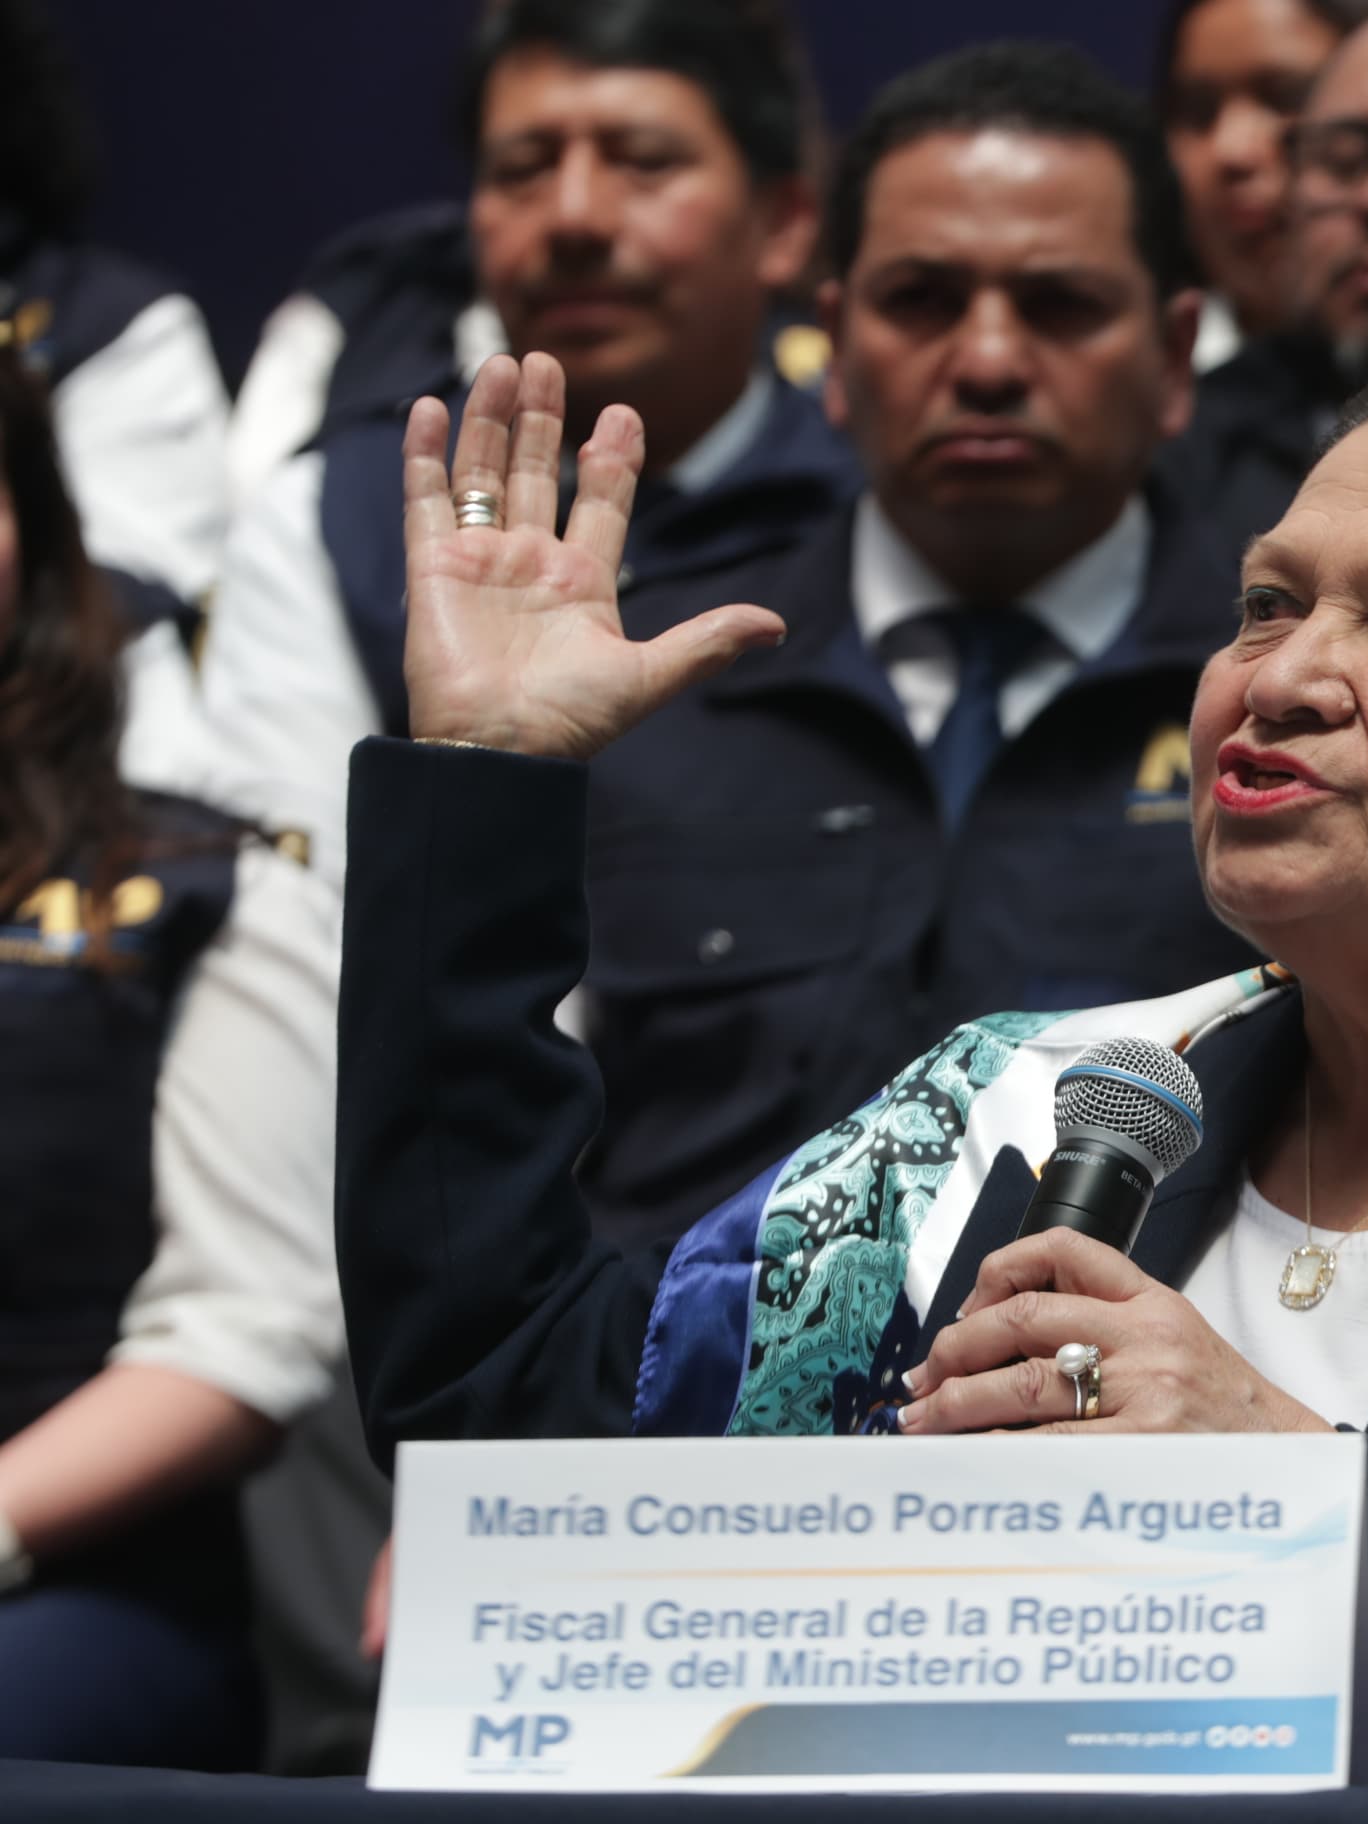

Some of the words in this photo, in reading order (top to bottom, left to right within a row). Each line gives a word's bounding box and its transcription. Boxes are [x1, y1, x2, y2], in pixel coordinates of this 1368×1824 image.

[1054, 1151, 1100, 1168] SHURE
[1120, 1169, 1143, 1192] BETA
[468, 1494, 609, 1538] María
[626, 1494, 875, 1536] Consuelo
[893, 1492, 1062, 1533] Porras
[1078, 1491, 1283, 1542] Argueta
[472, 1601, 626, 1643] Fiscal
[643, 1600, 847, 1640] General
[864, 1599, 929, 1638] de
[946, 1598, 989, 1637] la
[1008, 1594, 1267, 1645] República
[494, 1661, 526, 1702] y
[539, 1652, 651, 1691] Jefe
[668, 1650, 747, 1689] del
[765, 1648, 1022, 1688] Ministerio
[1040, 1644, 1237, 1685] Público
[470, 1713, 572, 1757] MP
